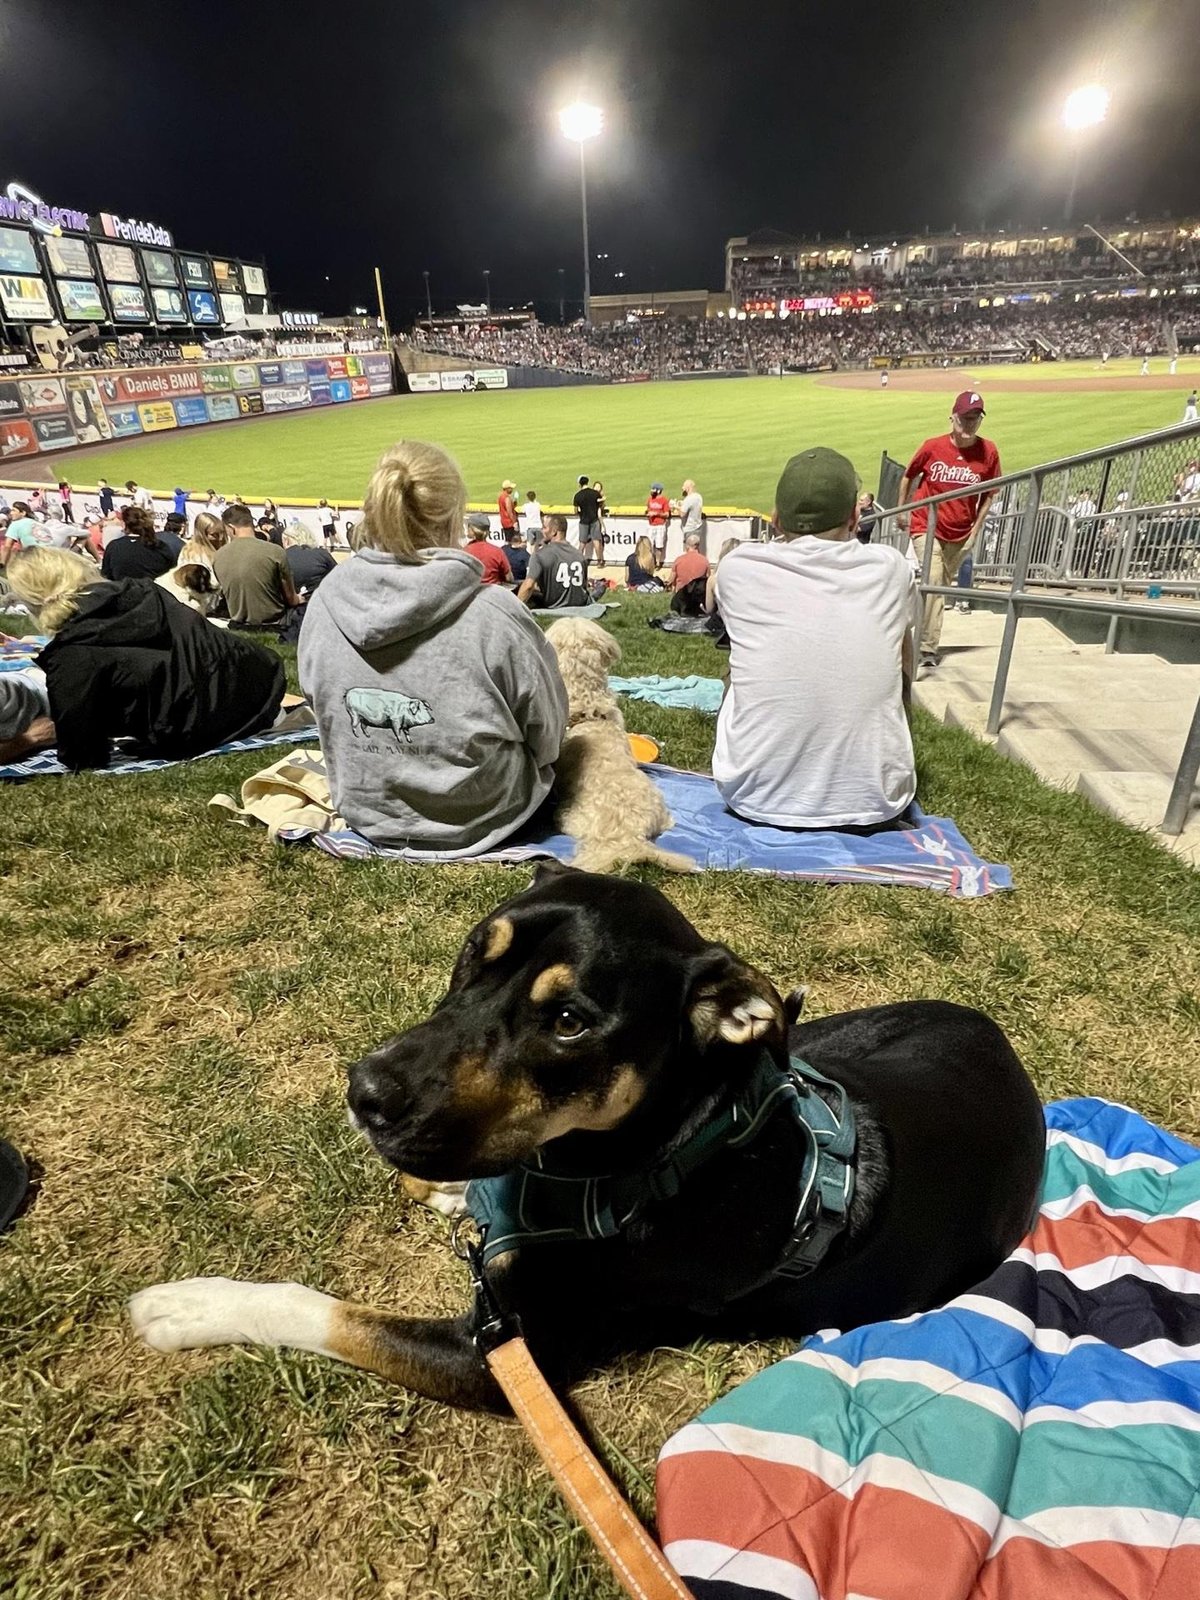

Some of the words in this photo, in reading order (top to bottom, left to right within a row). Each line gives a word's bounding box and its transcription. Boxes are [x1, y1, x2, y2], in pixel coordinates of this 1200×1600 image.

[36, 201, 91, 232] ELECTRIC
[113, 215, 172, 248] PenTeleData
[1, 278, 41, 299] WM
[125, 375, 169, 394] Daniels
[169, 371, 199, 389] BMW
[556, 561, 584, 588] 43
